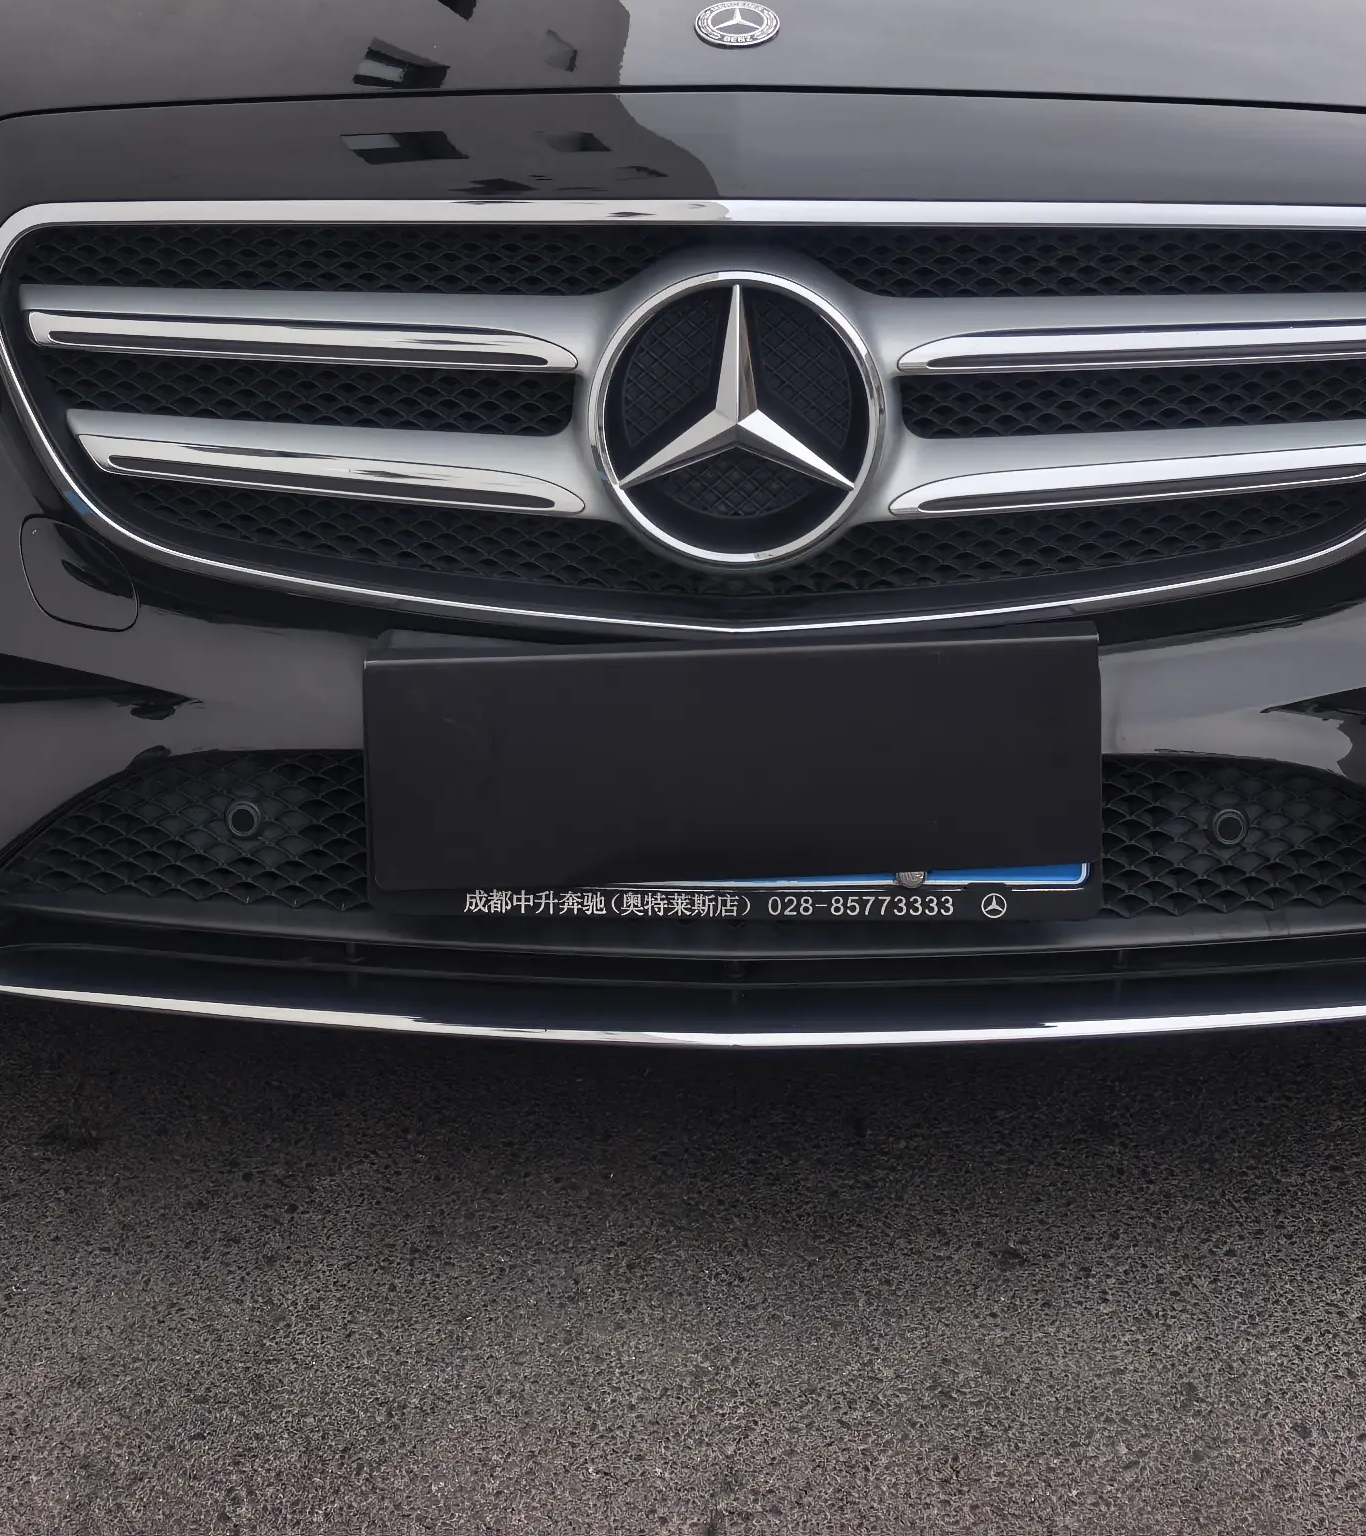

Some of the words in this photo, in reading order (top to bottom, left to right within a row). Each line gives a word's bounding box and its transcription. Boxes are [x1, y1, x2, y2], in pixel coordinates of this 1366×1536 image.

[463, 889, 752, 917] 成都中升奔驰（奥特莱斯店）
[767, 895, 955, 917] 028-85773333
